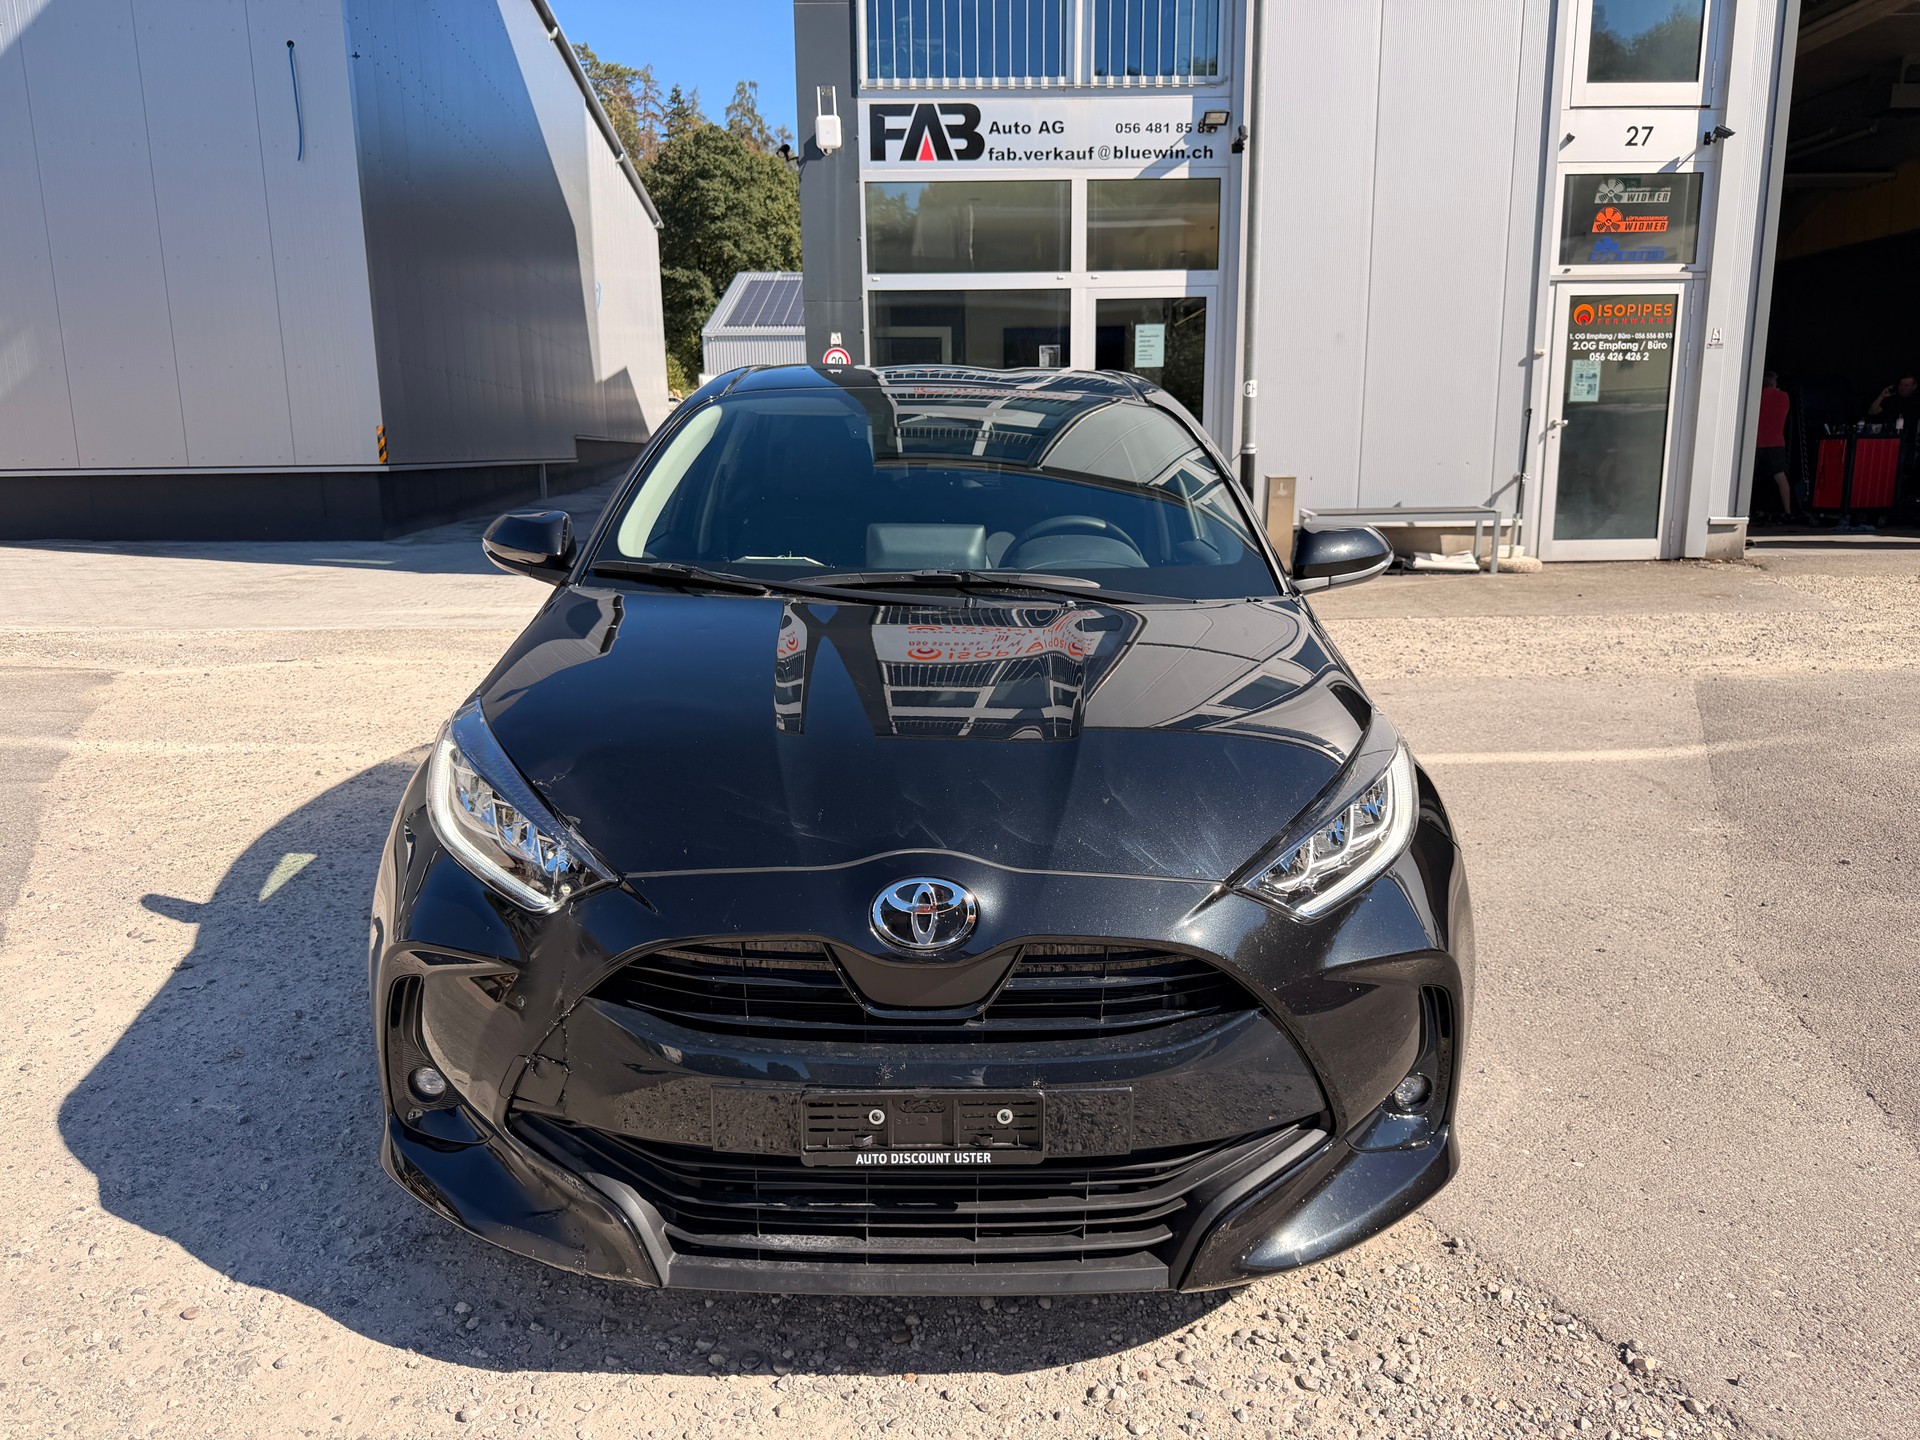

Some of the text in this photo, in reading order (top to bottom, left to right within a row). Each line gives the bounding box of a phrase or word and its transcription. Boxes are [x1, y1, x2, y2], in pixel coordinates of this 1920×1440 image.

[869, 103, 985, 161] FAB
[989, 121, 1065, 134] Auto AG
[1115, 123, 1141, 134] 056
[1145, 123, 1170, 134] 481
[1175, 123, 1193, 134] 85
[1625, 126, 1654, 146] 27
[1627, 192, 1669, 202] WIDMER
[1625, 222, 1666, 231] WIDMER
[1597, 303, 1673, 317] ISOPIPES
[1586, 333, 1613, 341] Empfang
[1598, 340, 1639, 352] Empfang
[1647, 341, 1668, 350] Büro
[1589, 352, 1650, 361] 056 426 426 2
[855, 1152, 992, 1165] AUTO DISCOUNT USTER
